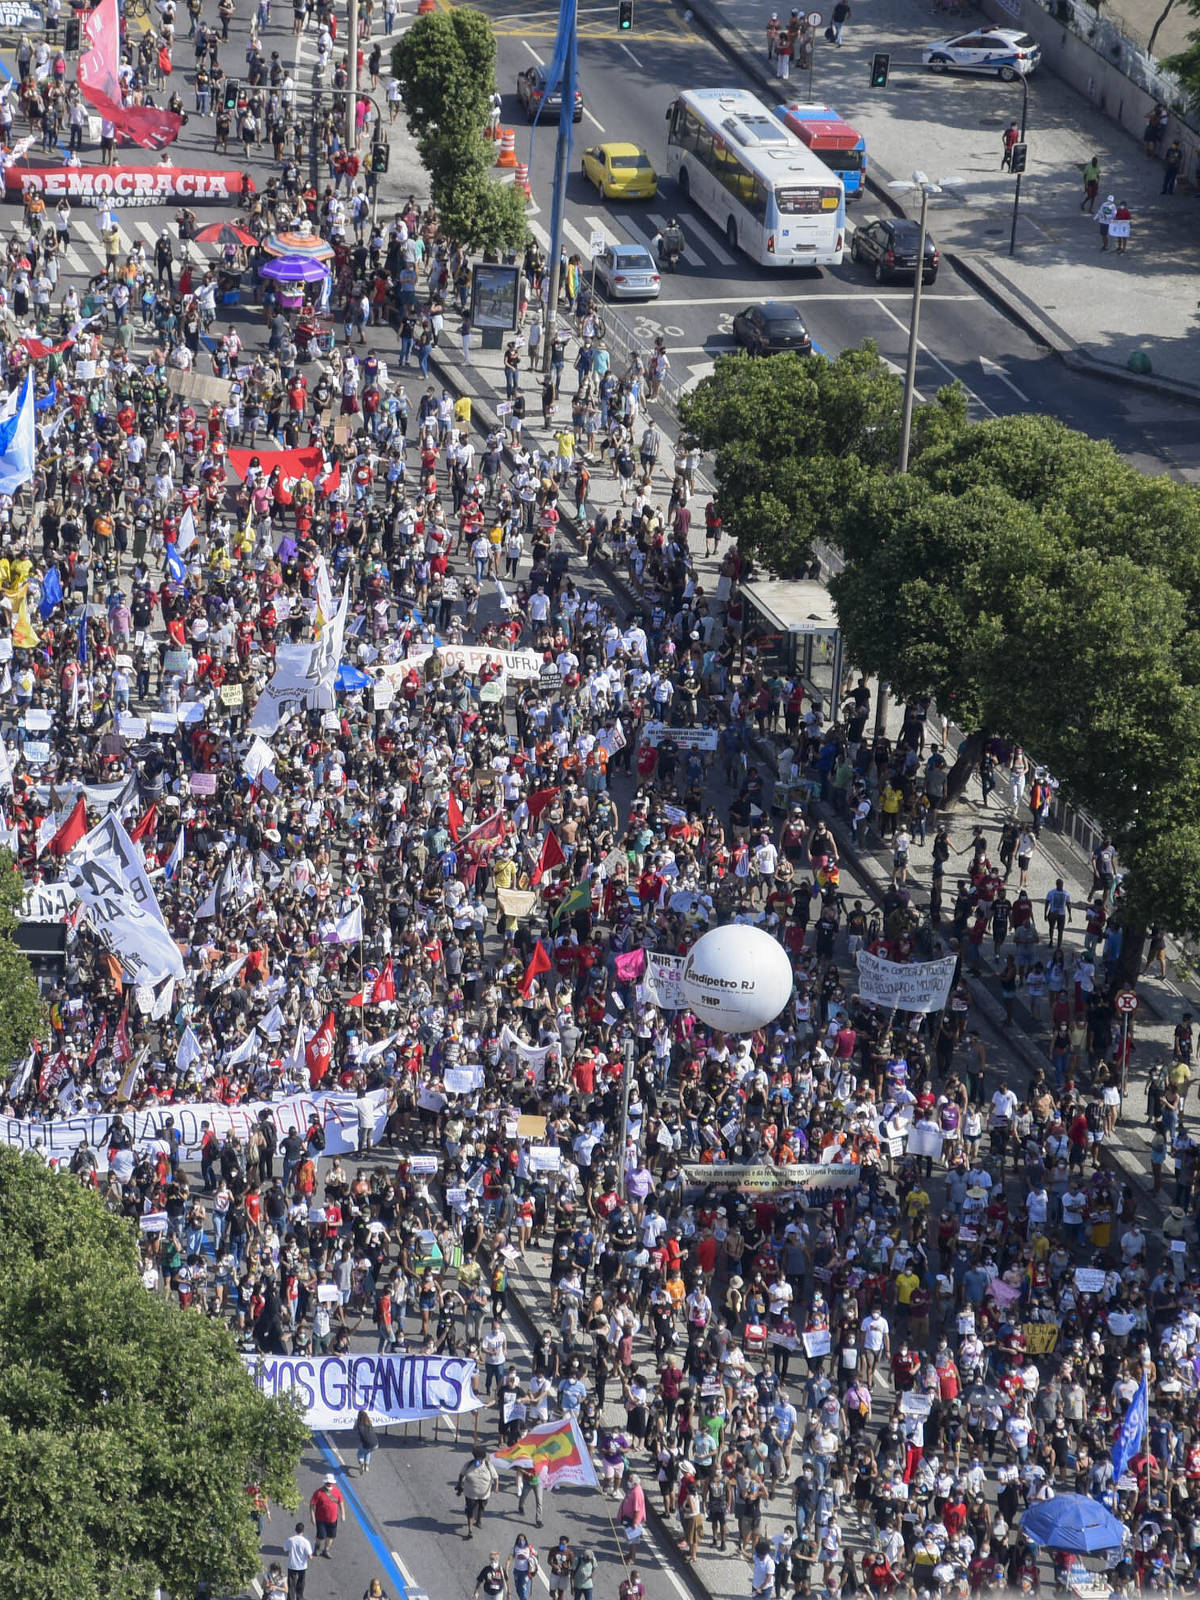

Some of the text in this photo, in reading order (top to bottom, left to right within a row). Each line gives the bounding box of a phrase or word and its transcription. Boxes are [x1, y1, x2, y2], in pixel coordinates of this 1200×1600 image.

[20, 173, 229, 198] DEMOCRACIA
[81, 196, 167, 208] RURO-NEGRA
[506, 655, 539, 672] UFRJ
[687, 969, 738, 990] Sindipetro
[741, 980, 755, 991] RJ
[805, 1168, 826, 1177] Sistema
[320, 1355, 468, 1412] GIGANTES
